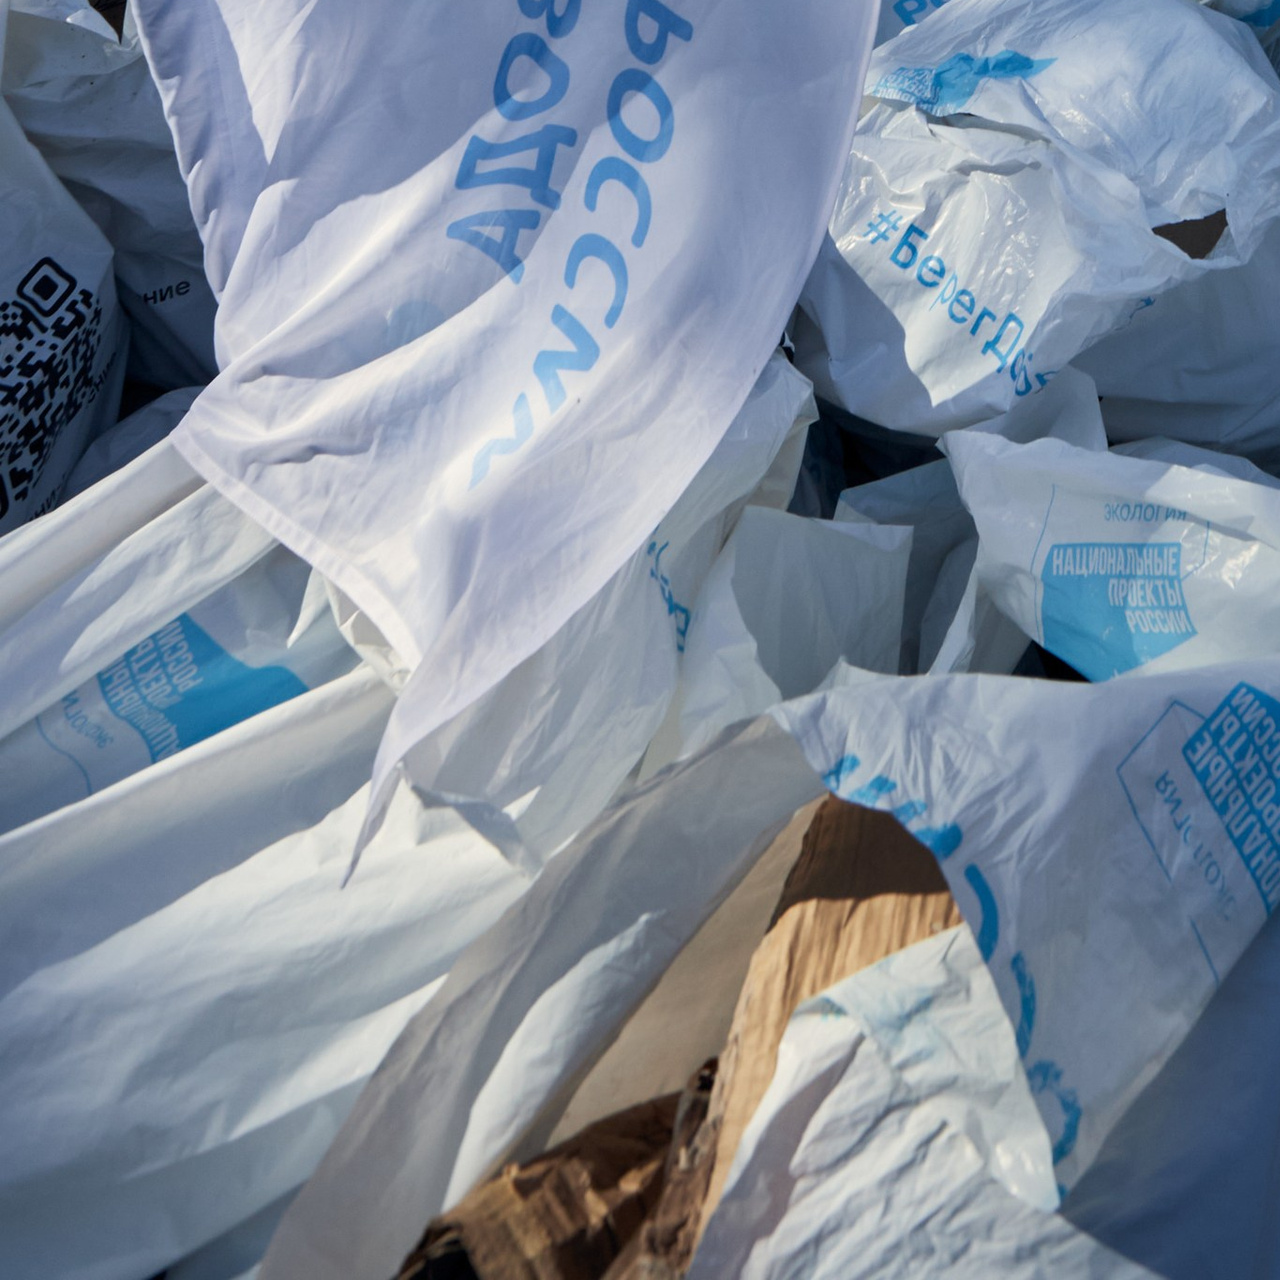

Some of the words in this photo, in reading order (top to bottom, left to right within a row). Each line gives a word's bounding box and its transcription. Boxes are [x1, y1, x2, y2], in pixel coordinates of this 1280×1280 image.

[1052, 547, 1178, 577] НАЦИОНАЛЬНЫЕ
[1109, 578, 1182, 606] ПРОЕКТЫ
[1125, 610, 1192, 634] РОССИИ
